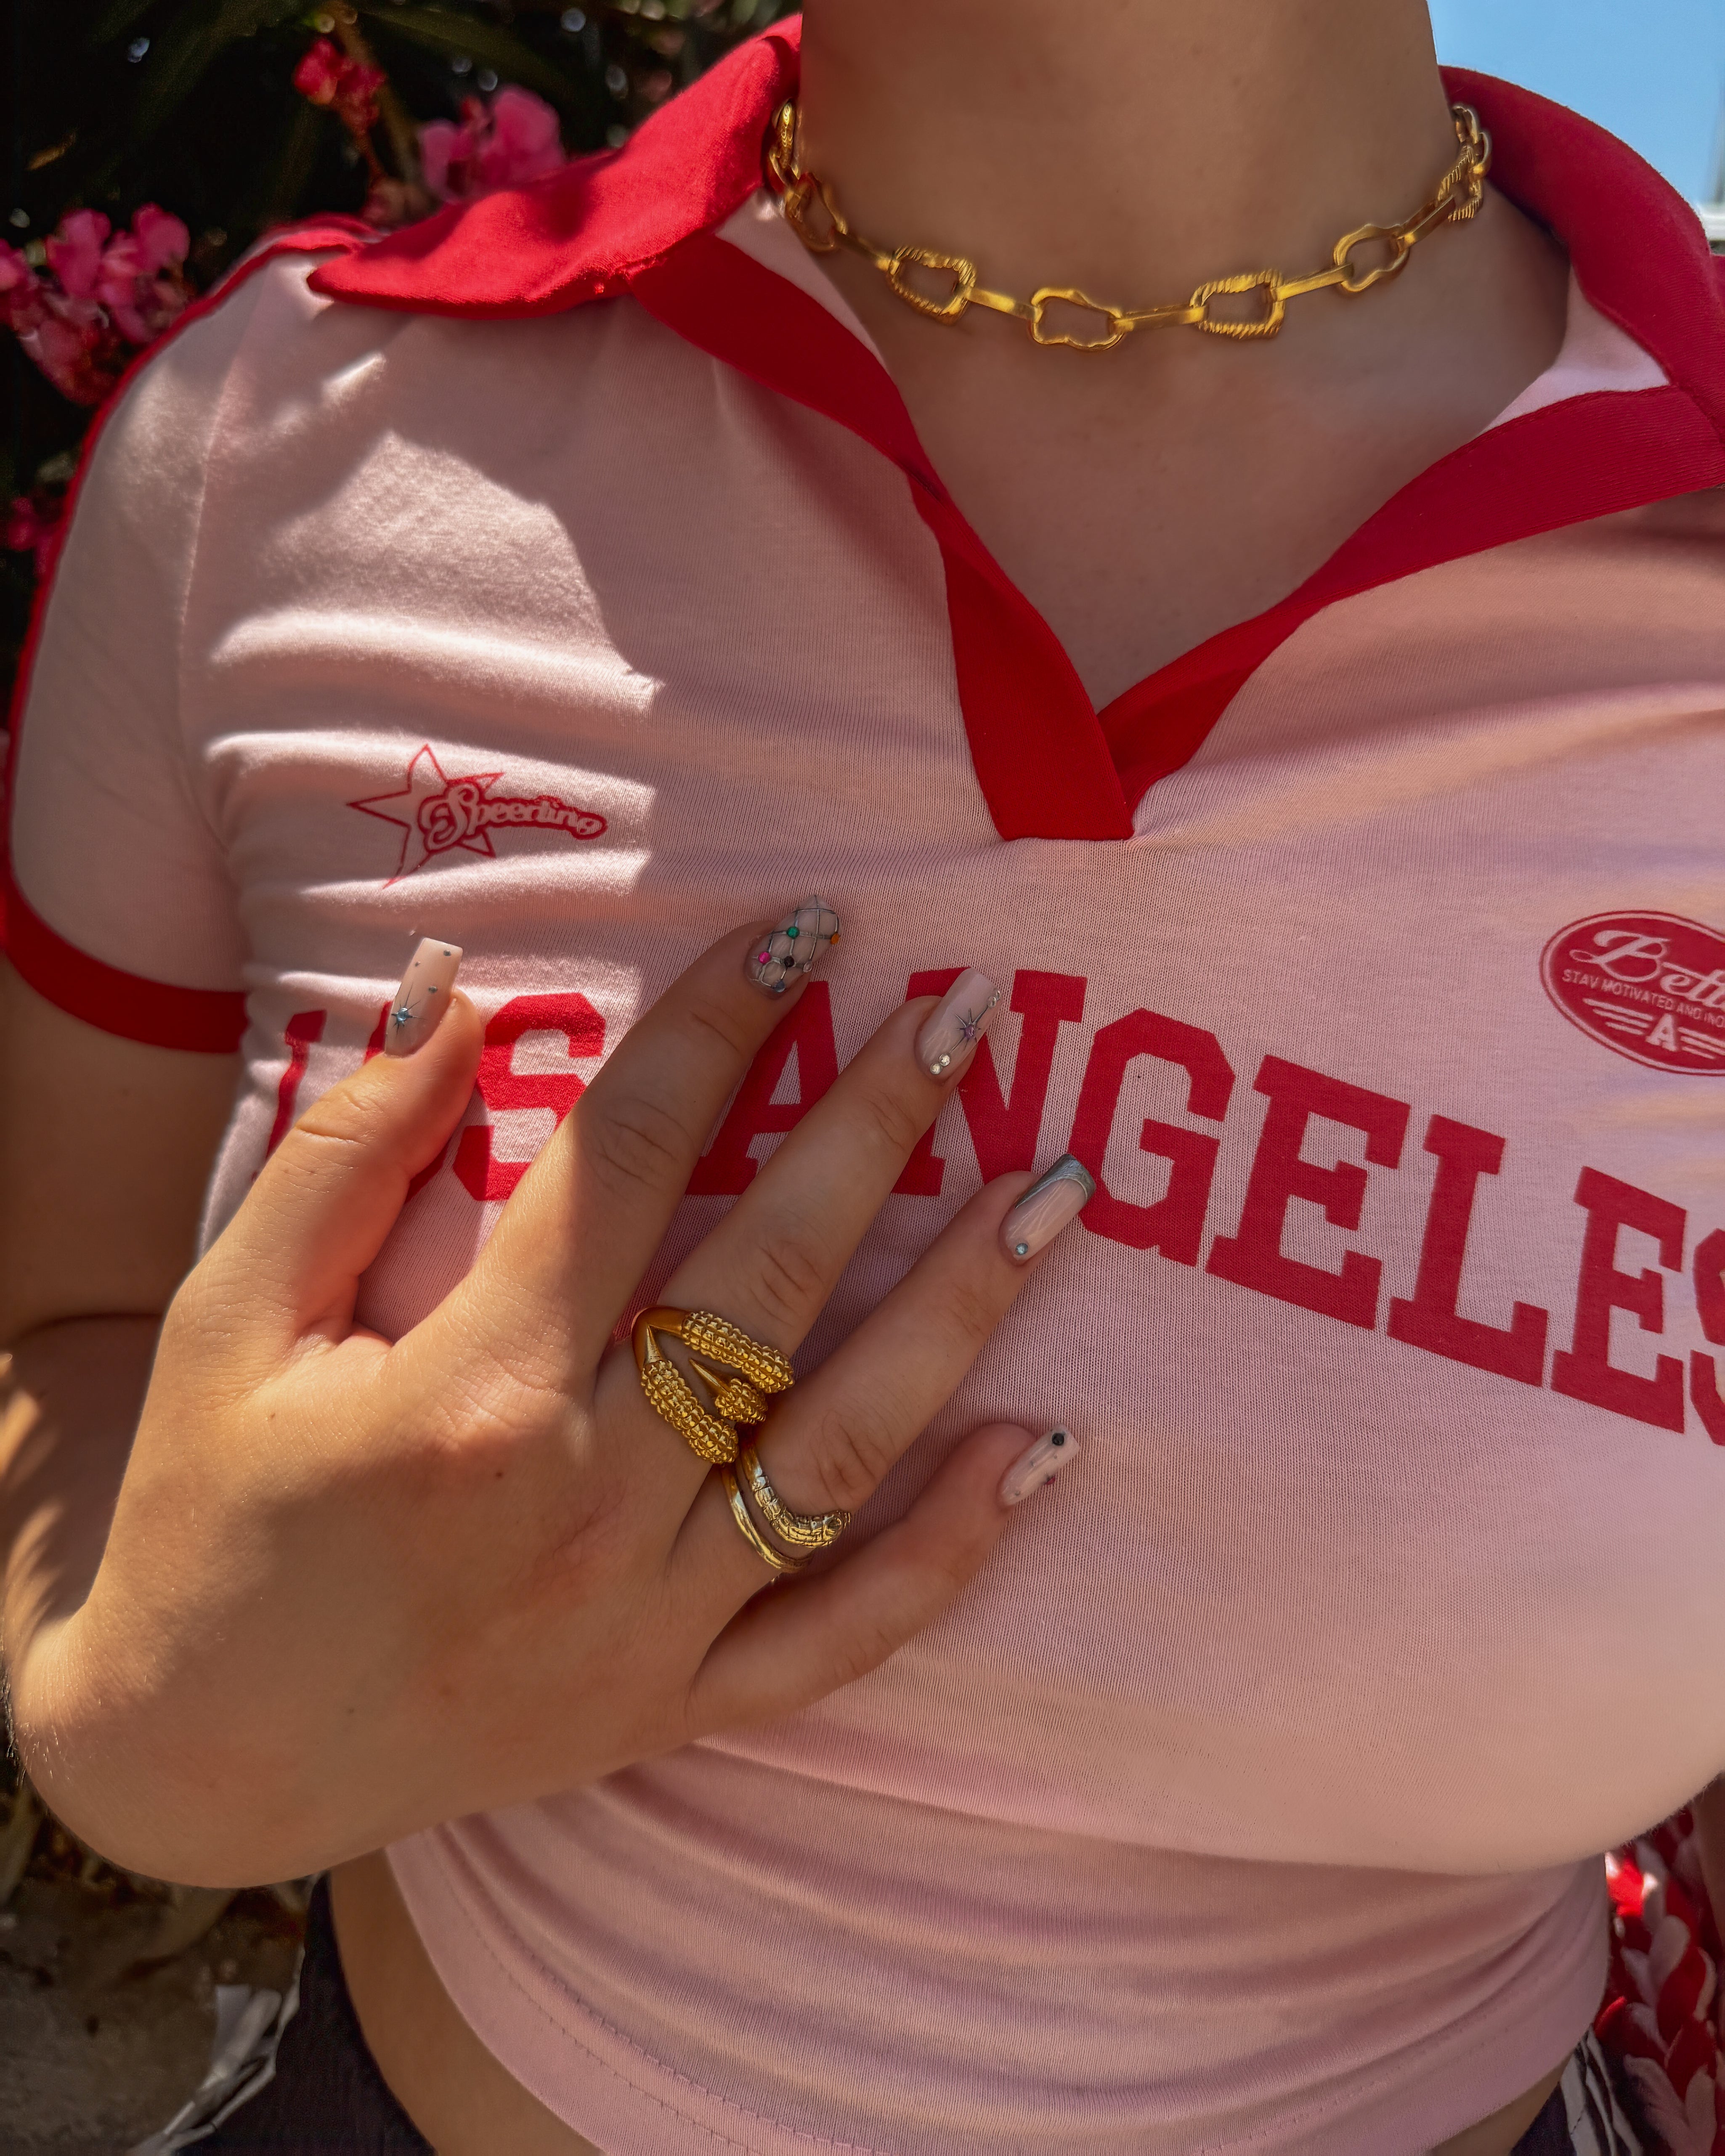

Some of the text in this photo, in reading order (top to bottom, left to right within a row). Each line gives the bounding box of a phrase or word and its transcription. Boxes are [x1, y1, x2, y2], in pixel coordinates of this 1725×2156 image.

[1601, 979, 1673, 1010] MOTIVATED
[1676, 1002, 1701, 1019] AND
[1645, 1013, 1677, 1051] A
